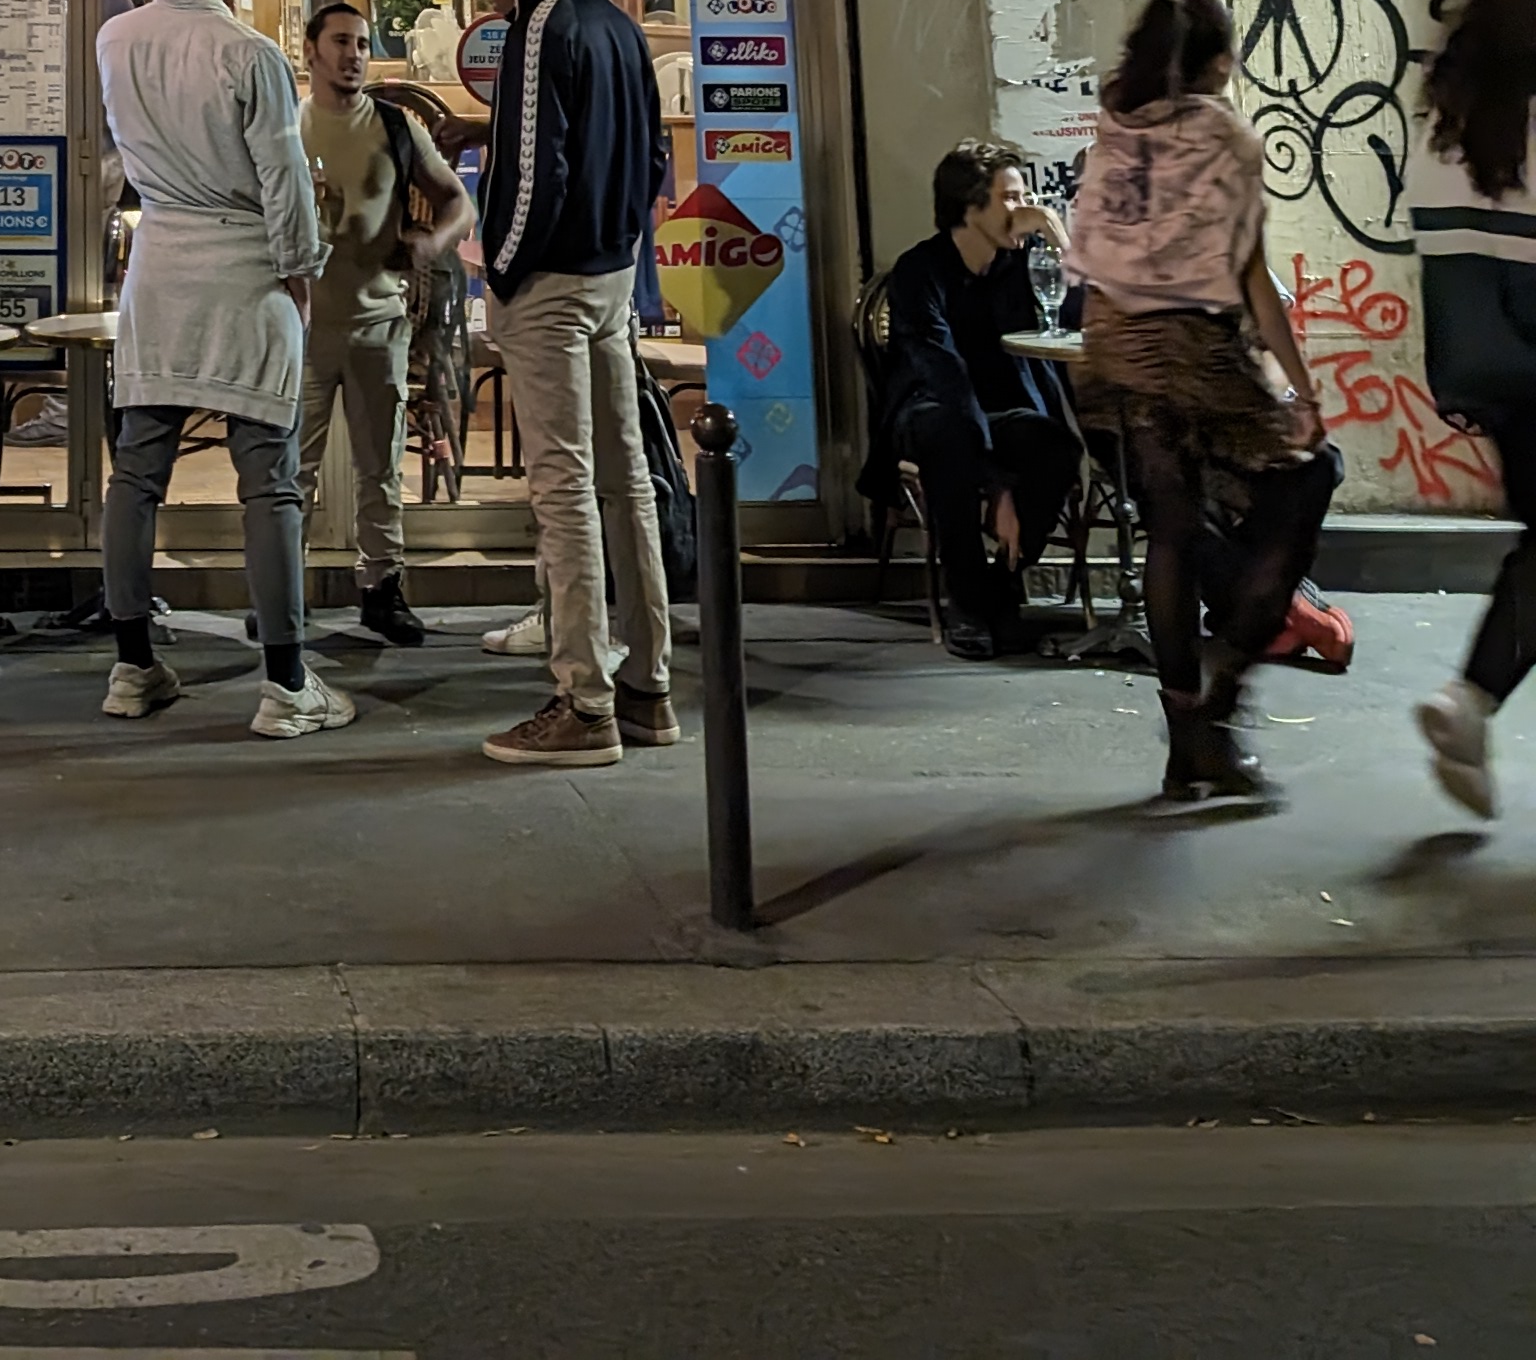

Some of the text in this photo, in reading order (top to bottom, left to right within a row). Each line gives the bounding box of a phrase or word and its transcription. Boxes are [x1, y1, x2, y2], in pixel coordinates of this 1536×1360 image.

[469, 55, 486, 64] JEU
[730, 87, 782, 98] PARIONS
[0, 187, 26, 207] 13
